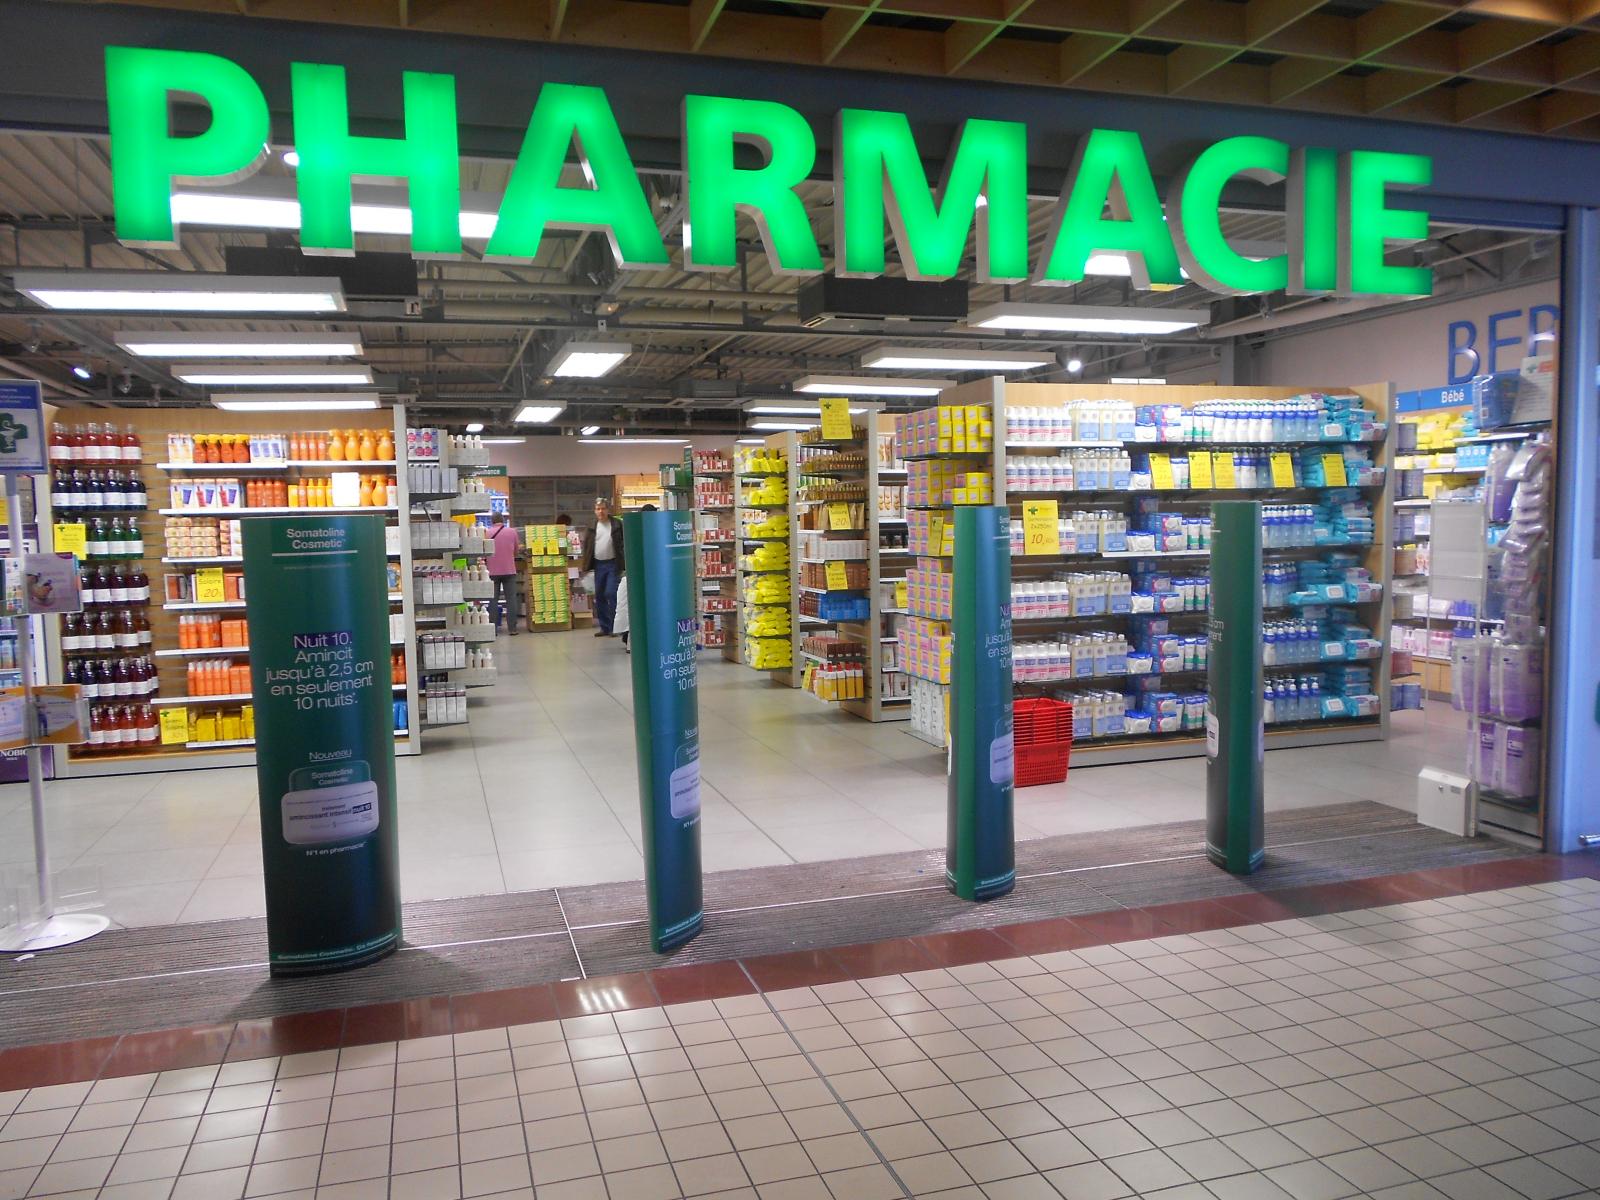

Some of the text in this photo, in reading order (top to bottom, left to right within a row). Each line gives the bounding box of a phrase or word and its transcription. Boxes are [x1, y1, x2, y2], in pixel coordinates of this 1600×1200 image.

[104, 45, 1433, 296] PHARMACIE
[1441, 389, 1465, 403] Bébé
[286, 527, 345, 538] Somatoline
[292, 539, 343, 550] Cosmetic
[294, 632, 352, 649] Nuit 10.
[294, 648, 352, 664] Amincit
[988, 648, 999, 658] en
[265, 660, 374, 684] jusqu'à 2,5 cm
[664, 669, 677, 680] en
[270, 675, 373, 696] en seulement
[678, 678, 687, 691] 10
[294, 696, 313, 710] 10
[309, 749, 352, 761] Nouveau
